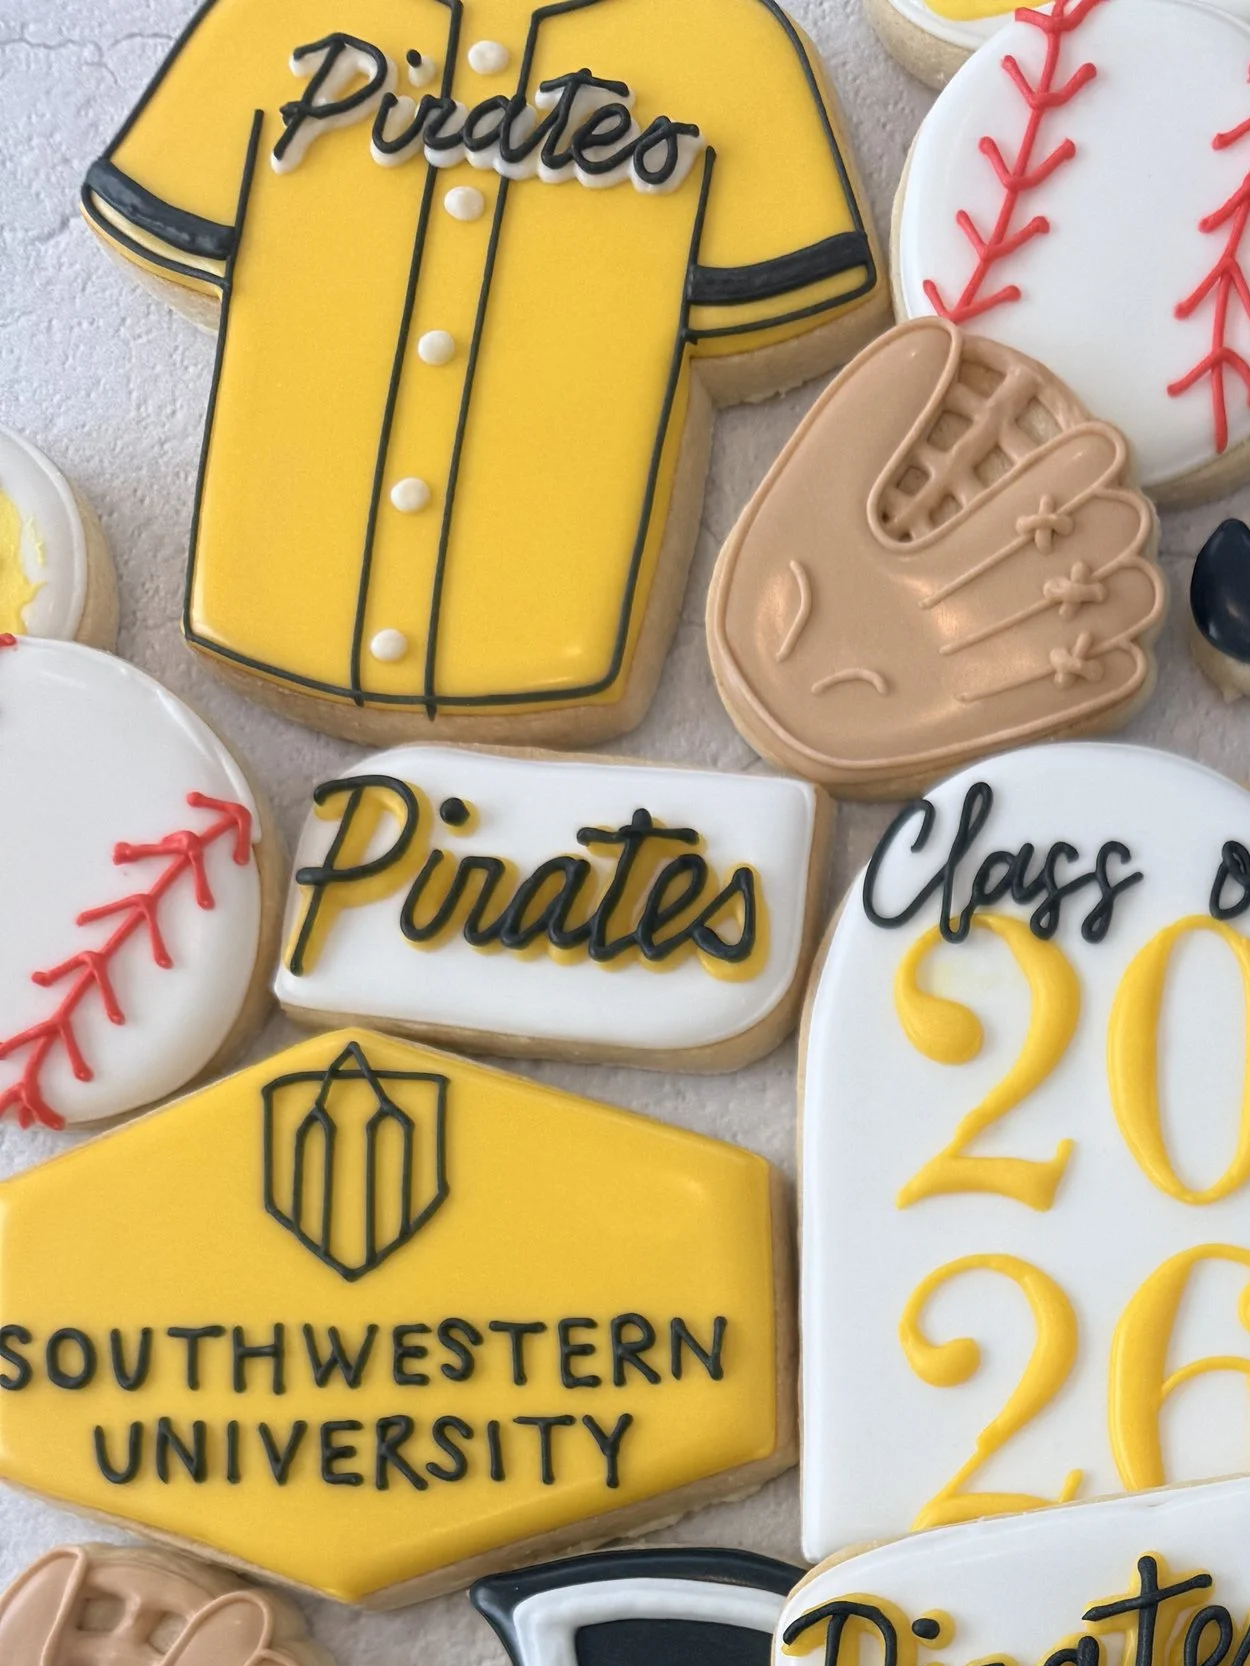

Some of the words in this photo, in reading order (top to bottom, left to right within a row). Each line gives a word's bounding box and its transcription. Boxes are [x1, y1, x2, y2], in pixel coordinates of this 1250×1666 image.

[273, 32, 701, 188] Pirates
[290, 774, 757, 976] Pirates
[862, 781, 1144, 943] Class
[0, 1315, 728, 1395] SOUTHWESTERN
[94, 1413, 633, 1490] UNIVERSITY
